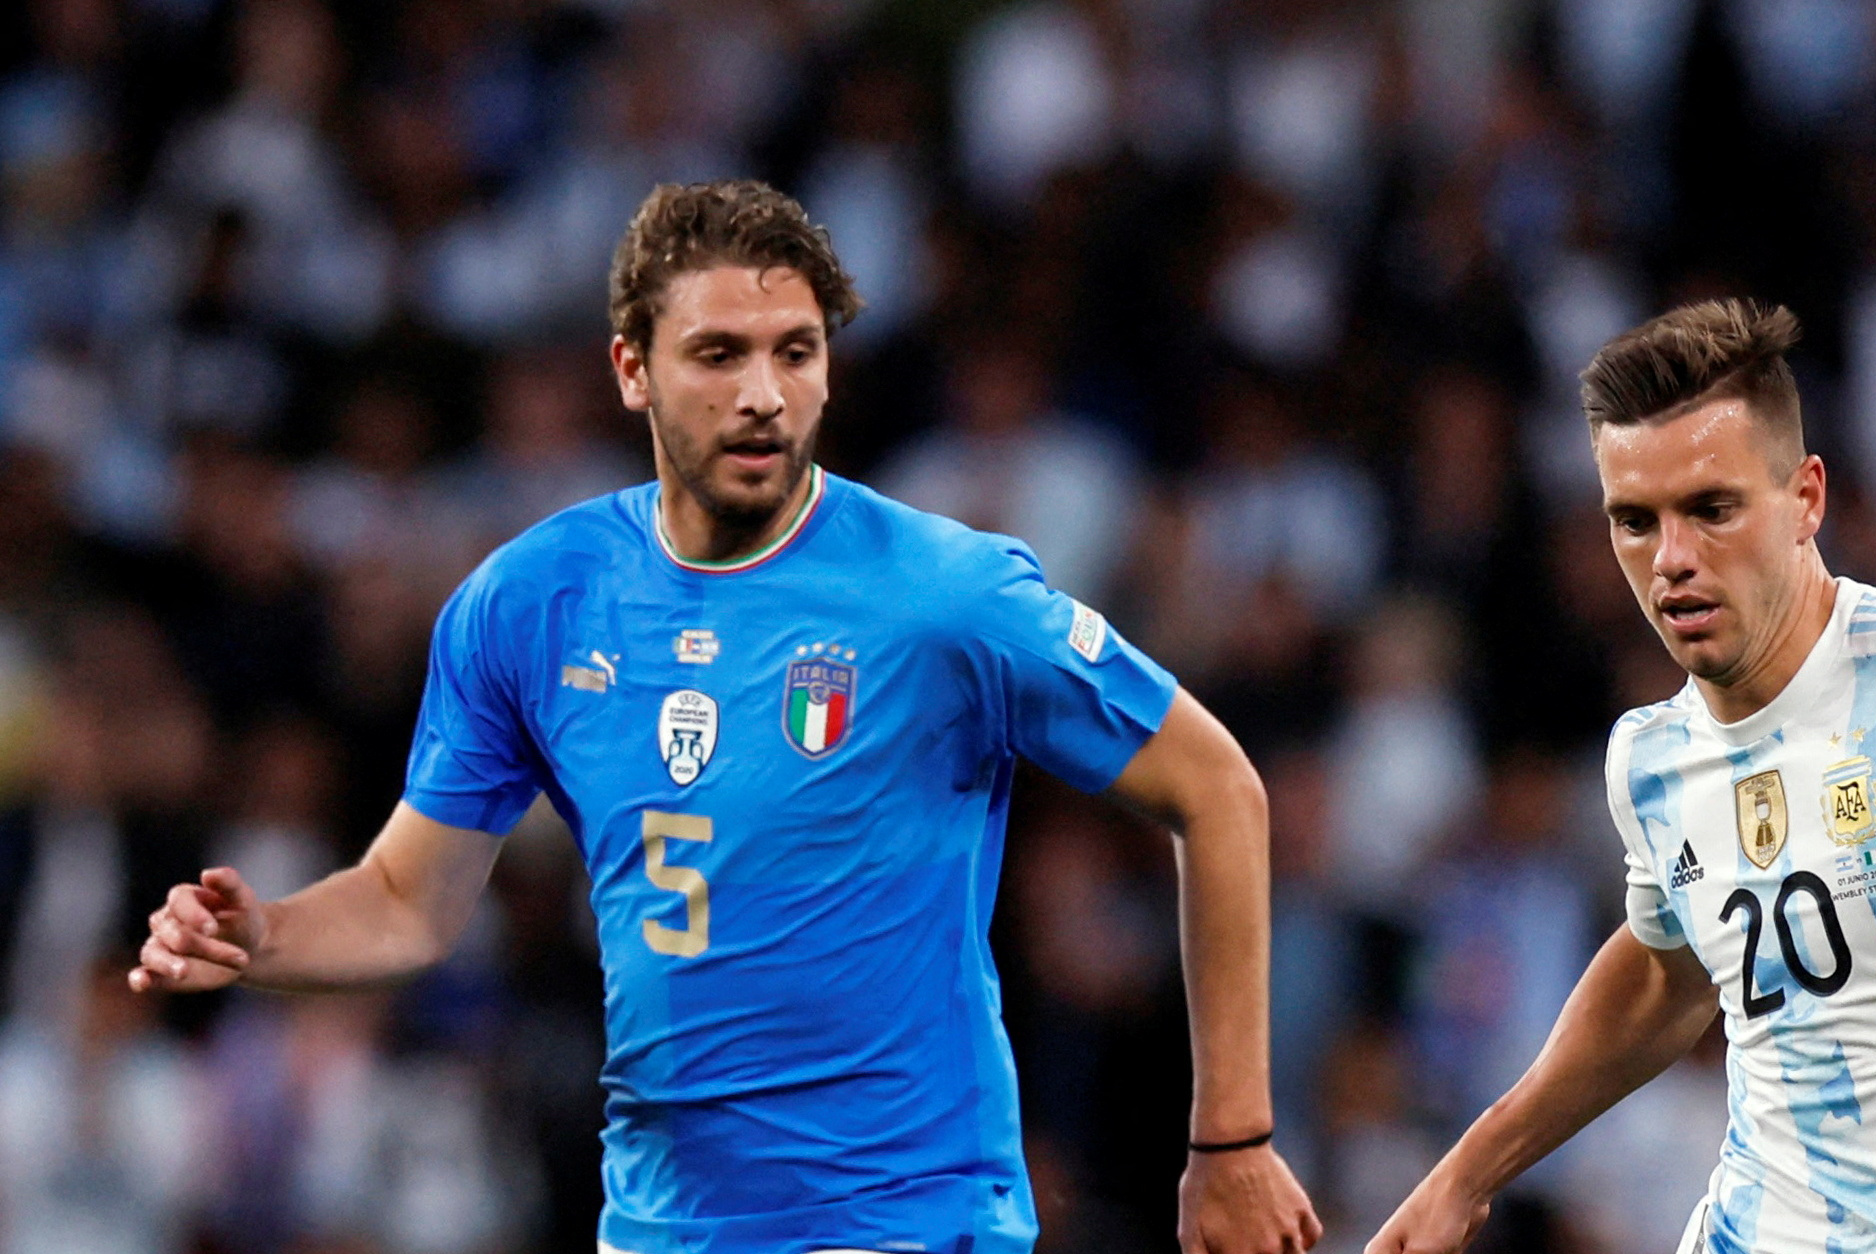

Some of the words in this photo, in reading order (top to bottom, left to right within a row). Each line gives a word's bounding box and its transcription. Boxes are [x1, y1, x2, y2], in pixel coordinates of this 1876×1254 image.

[1835, 781, 1866, 821] AFA
[643, 810, 712, 957] 5
[1671, 866, 1704, 889] adidas
[1848, 872, 1869, 885] JUNIO
[1831, 888, 1868, 901] WEMBLEY
[1718, 870, 1852, 1020] 20
